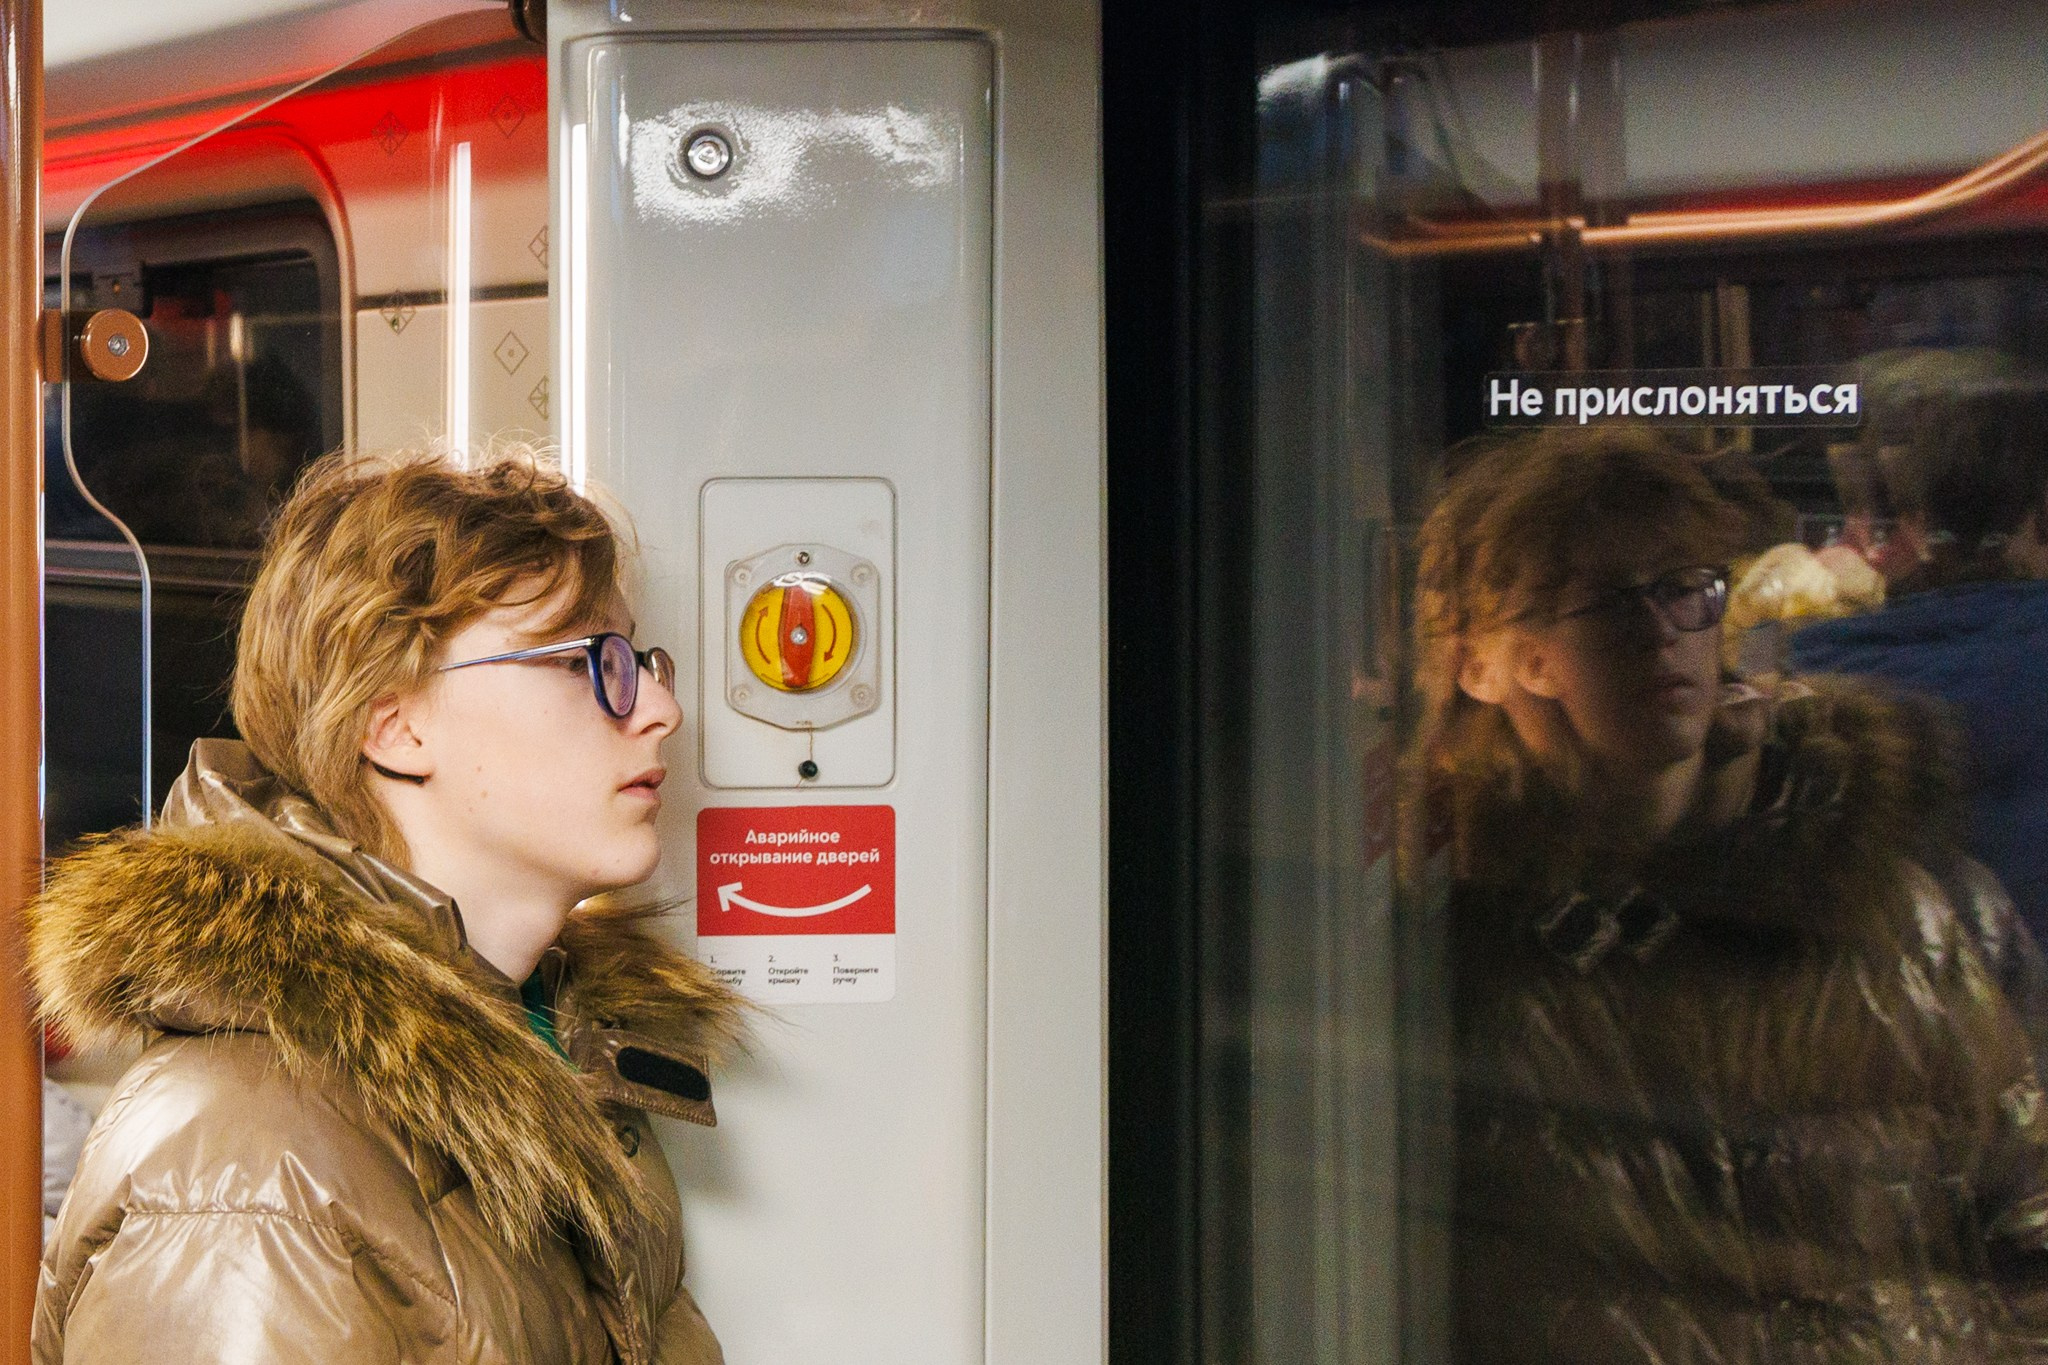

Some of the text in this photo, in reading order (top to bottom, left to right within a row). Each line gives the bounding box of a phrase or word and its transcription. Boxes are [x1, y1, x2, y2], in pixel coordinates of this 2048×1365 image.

[1490, 379, 1858, 424] Не прислоняться
[745, 829, 840, 847] Аварийное
[710, 849, 880, 867] открывание дверей
[768, 954, 776, 963] 2.
[768, 967, 808, 976] Откройте
[832, 966, 879, 975] Поверните
[768, 977, 801, 986] крышку
[832, 977, 857, 985] ручку
